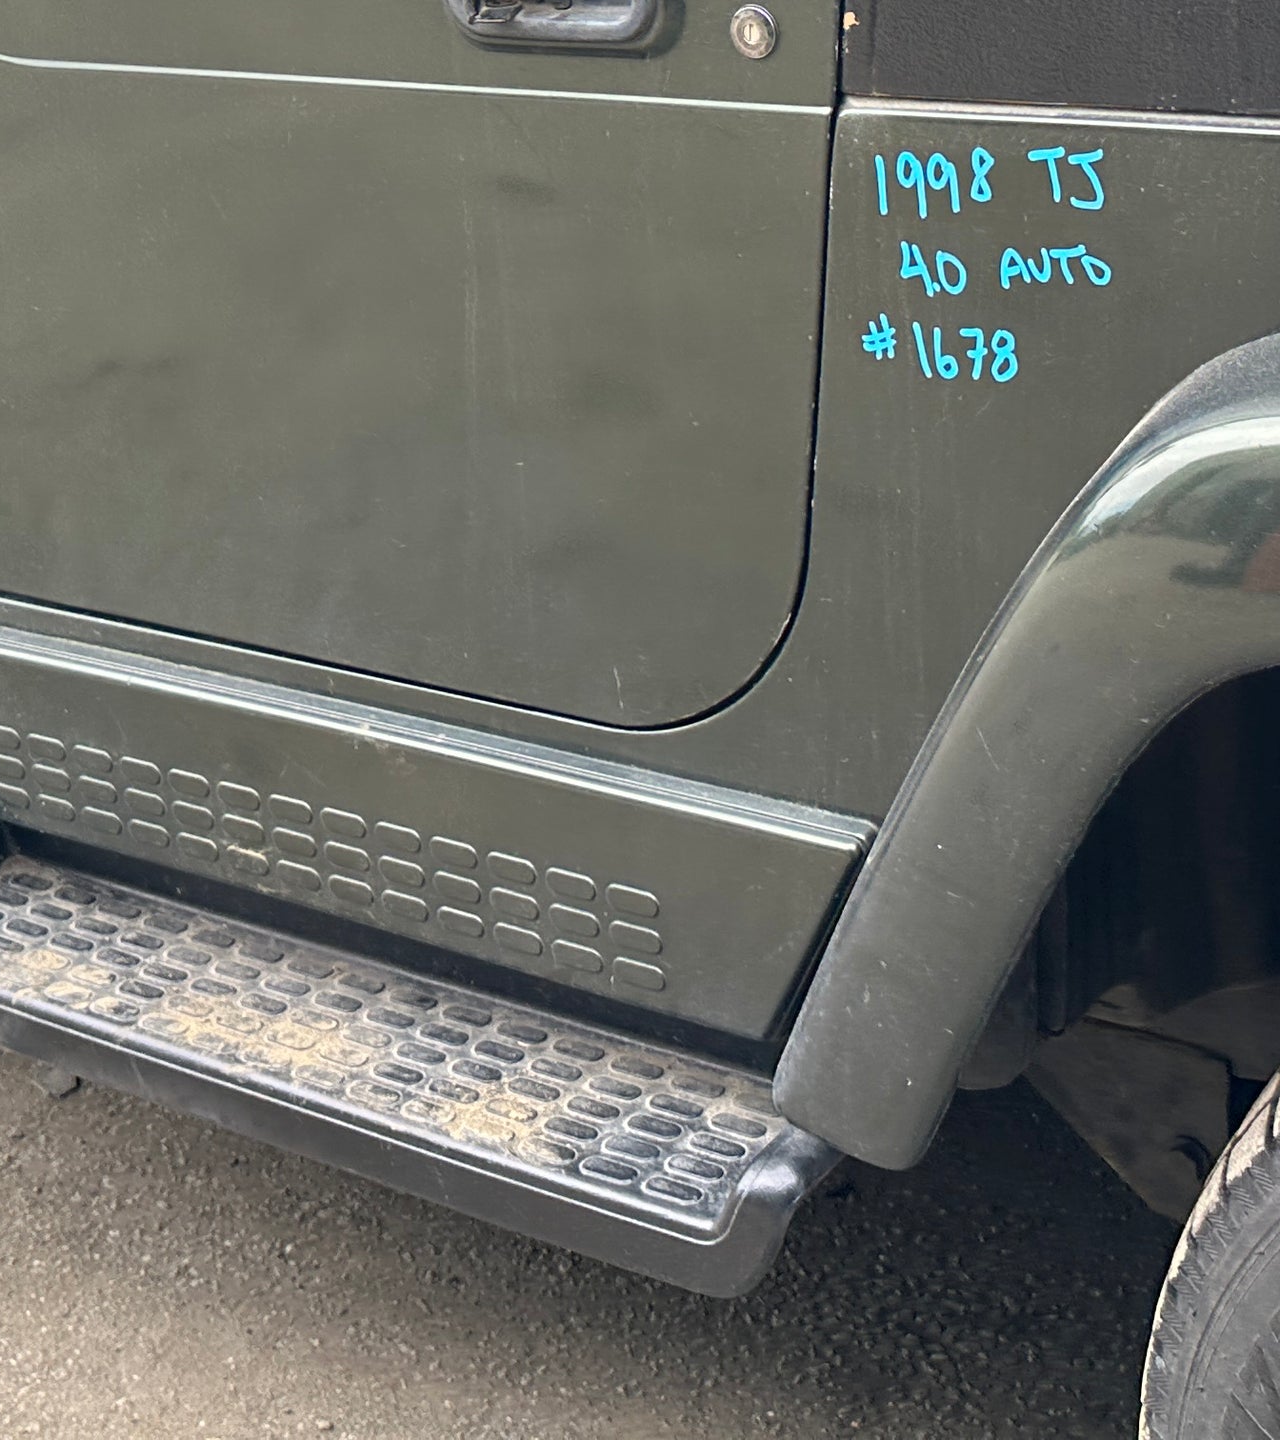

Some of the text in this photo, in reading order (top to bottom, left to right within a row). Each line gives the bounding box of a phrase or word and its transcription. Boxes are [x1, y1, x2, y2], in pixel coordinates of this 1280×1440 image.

[874, 146, 1106, 220] 1998 TJ
[899, 240, 1112, 298] 4.0 AUTO
